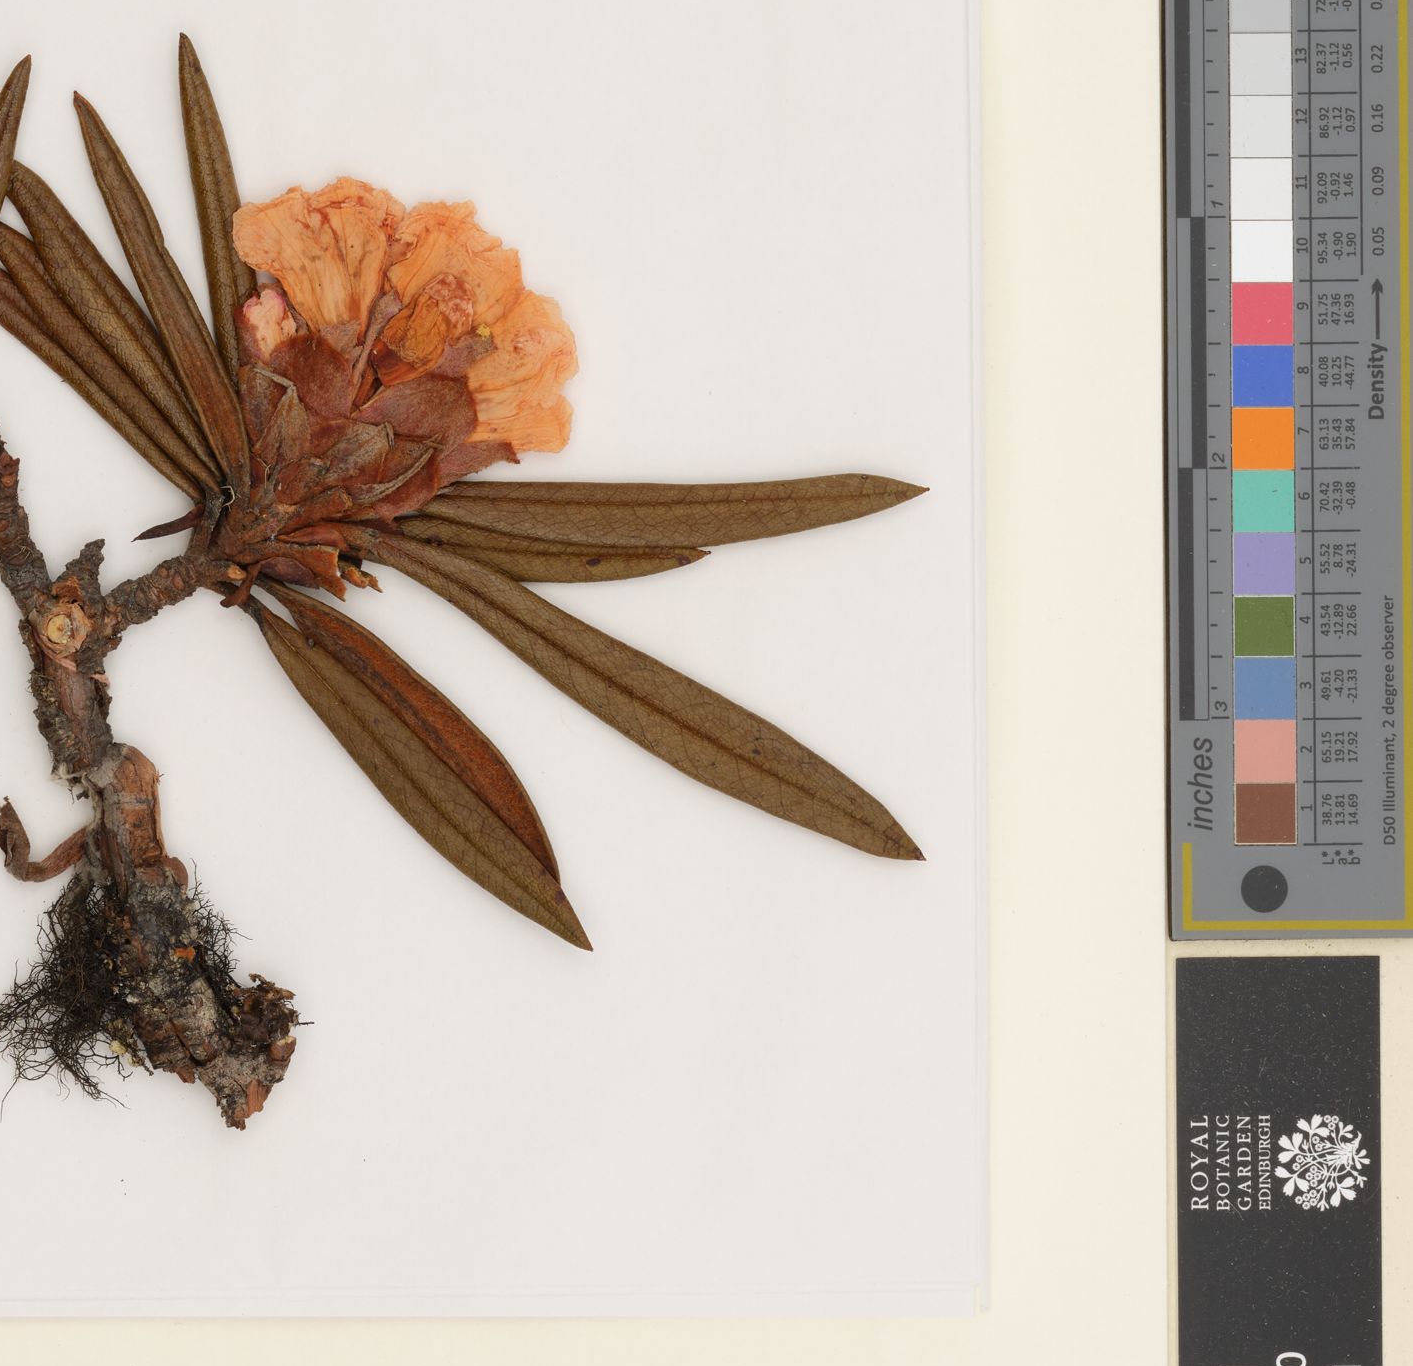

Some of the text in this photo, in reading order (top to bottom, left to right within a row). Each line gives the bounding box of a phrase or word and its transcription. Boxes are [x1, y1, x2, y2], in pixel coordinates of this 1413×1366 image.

[1370, 44, 1384, 74] 0.22
[1370, 103, 1384, 133] 0.16
[1370, 166, 1385, 196] 0.09
[1371, 226, 1385, 257] 0.05
[1366, 342, 1389, 420] Density
[1211, 451, 1226, 464] 2
[1214, 700, 1228, 713] 3
[1380, 594, 1398, 846] D50 Illuminant, 2 degree observer
[1186, 737, 1214, 831] inches
[1190, 1115, 1209, 1211] ROYAL
[1215, 1115, 1231, 1212] BOTANIC
[1236, 1115, 1252, 1211] GARDEN
[1257, 1114, 1272, 1211] EDINBURGH
